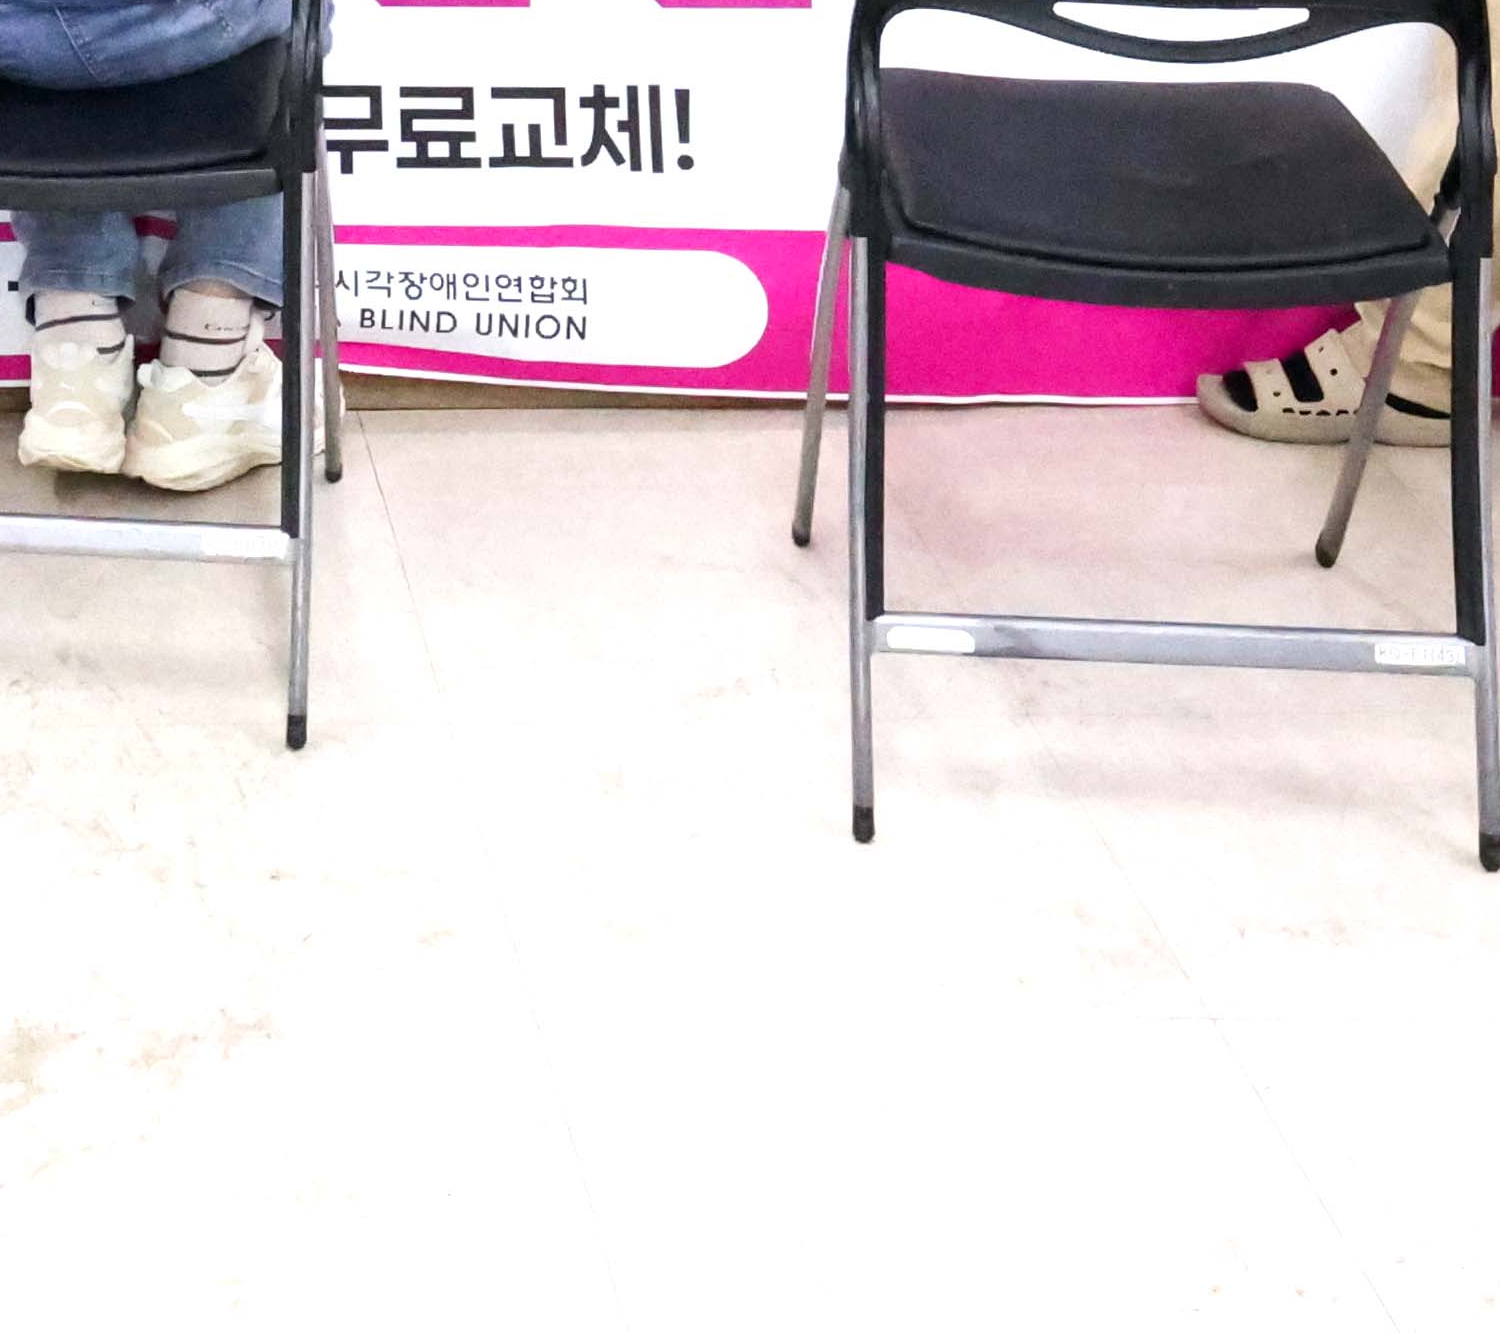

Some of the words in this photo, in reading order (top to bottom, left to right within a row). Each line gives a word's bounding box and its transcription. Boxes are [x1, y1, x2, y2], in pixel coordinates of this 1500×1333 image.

[333, 267, 587, 308] 시각장애인연합회
[360, 308, 457, 333] BLIND
[476, 313, 586, 340] UNION
